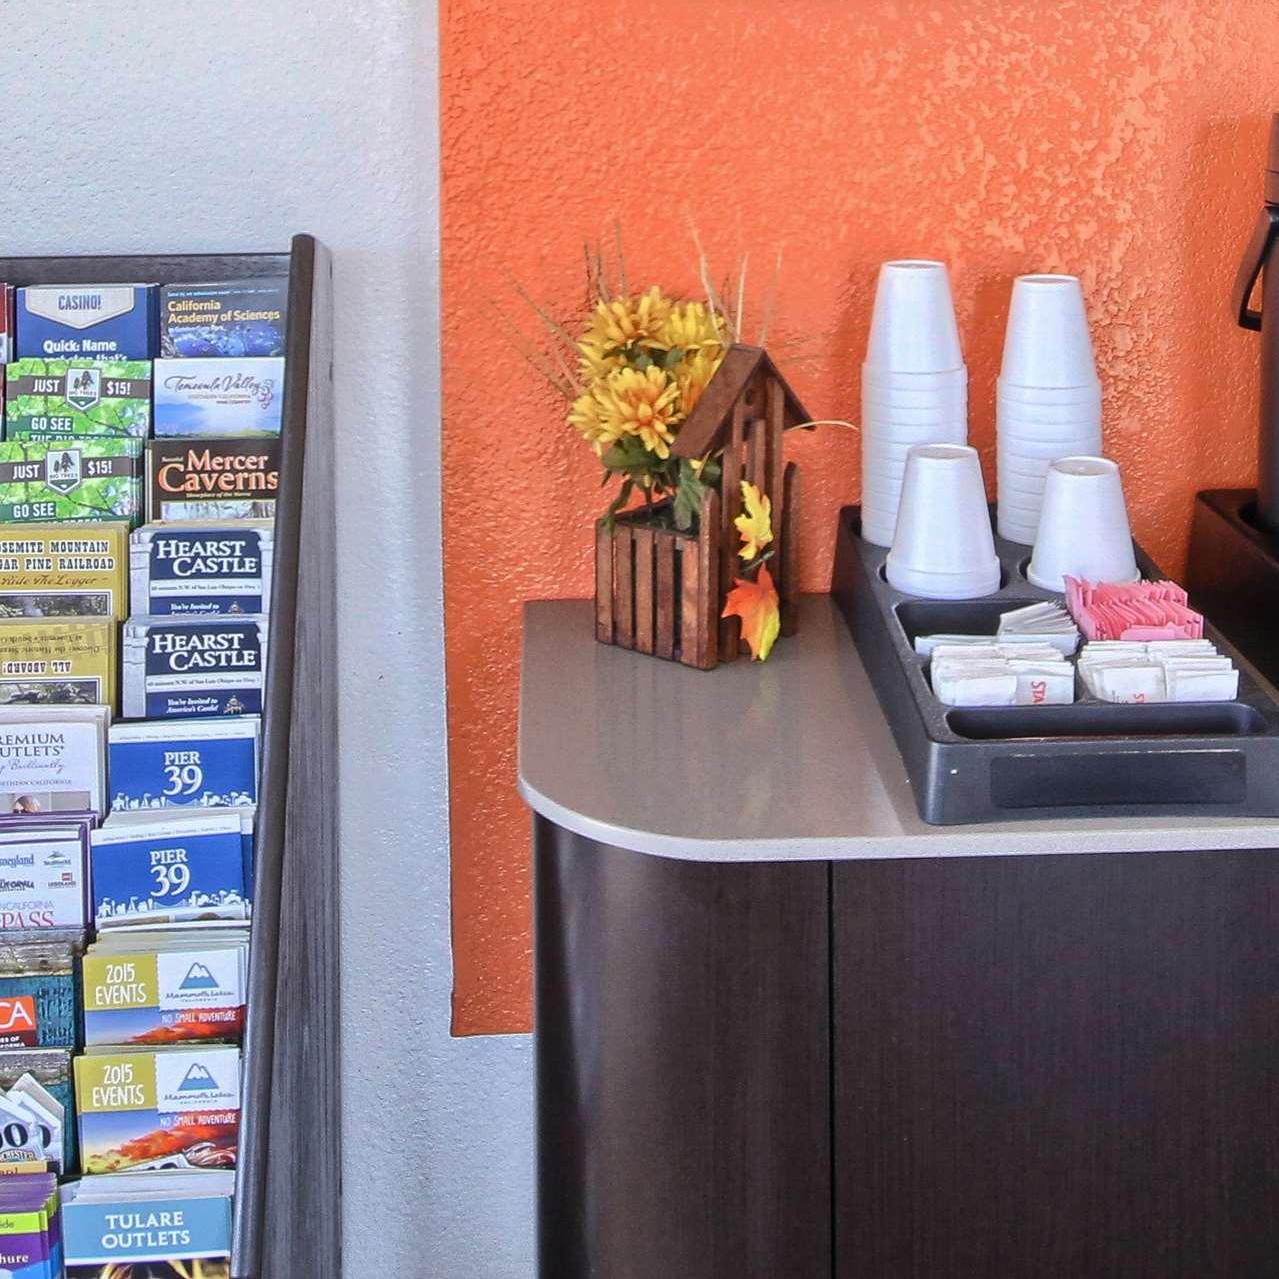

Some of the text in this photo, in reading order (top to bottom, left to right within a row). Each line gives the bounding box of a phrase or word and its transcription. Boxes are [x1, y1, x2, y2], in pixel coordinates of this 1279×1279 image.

[58, 295, 102, 310] CASINO!
[167, 300, 221, 312] California
[167, 309, 280, 324] Academy of Sciences
[42, 339, 117, 353] Quick: Name
[33, 380, 60, 393] JUST
[106, 382, 131, 395] $15!
[31, 417, 71, 430] GO SEE
[187, 448, 269, 471] Mercer
[12, 465, 39, 479] JUST
[88, 461, 112, 475] $15!
[158, 462, 279, 494] Caverns
[13, 502, 55, 517] GO SEE
[50, 541, 109, 553] MOUNTAIN
[156, 540, 246, 559] HEARST
[25, 559, 52, 570] PINE
[59, 558, 114, 570] RAILROAD
[173, 557, 257, 576] CASTLE
[153, 634, 244, 653] HEARST
[170, 651, 256, 671] CASTLE
[163, 751, 201, 766] PIER
[162, 765, 203, 796] 39
[149, 848, 188, 865] PIER
[149, 863, 190, 897] 39
[106, 963, 135, 984] 2015
[95, 983, 147, 1005] EVENTS
[162, 1011, 236, 1023] NO SMALL ADVENTURE
[104, 1064, 133, 1084] 2015
[92, 1084, 145, 1107] EVENTS
[160, 1113, 237, 1126] NO SMALL ADVENTURE
[105, 1211, 184, 1230] TULARE
[101, 1230, 191, 1249] OUTLETS
